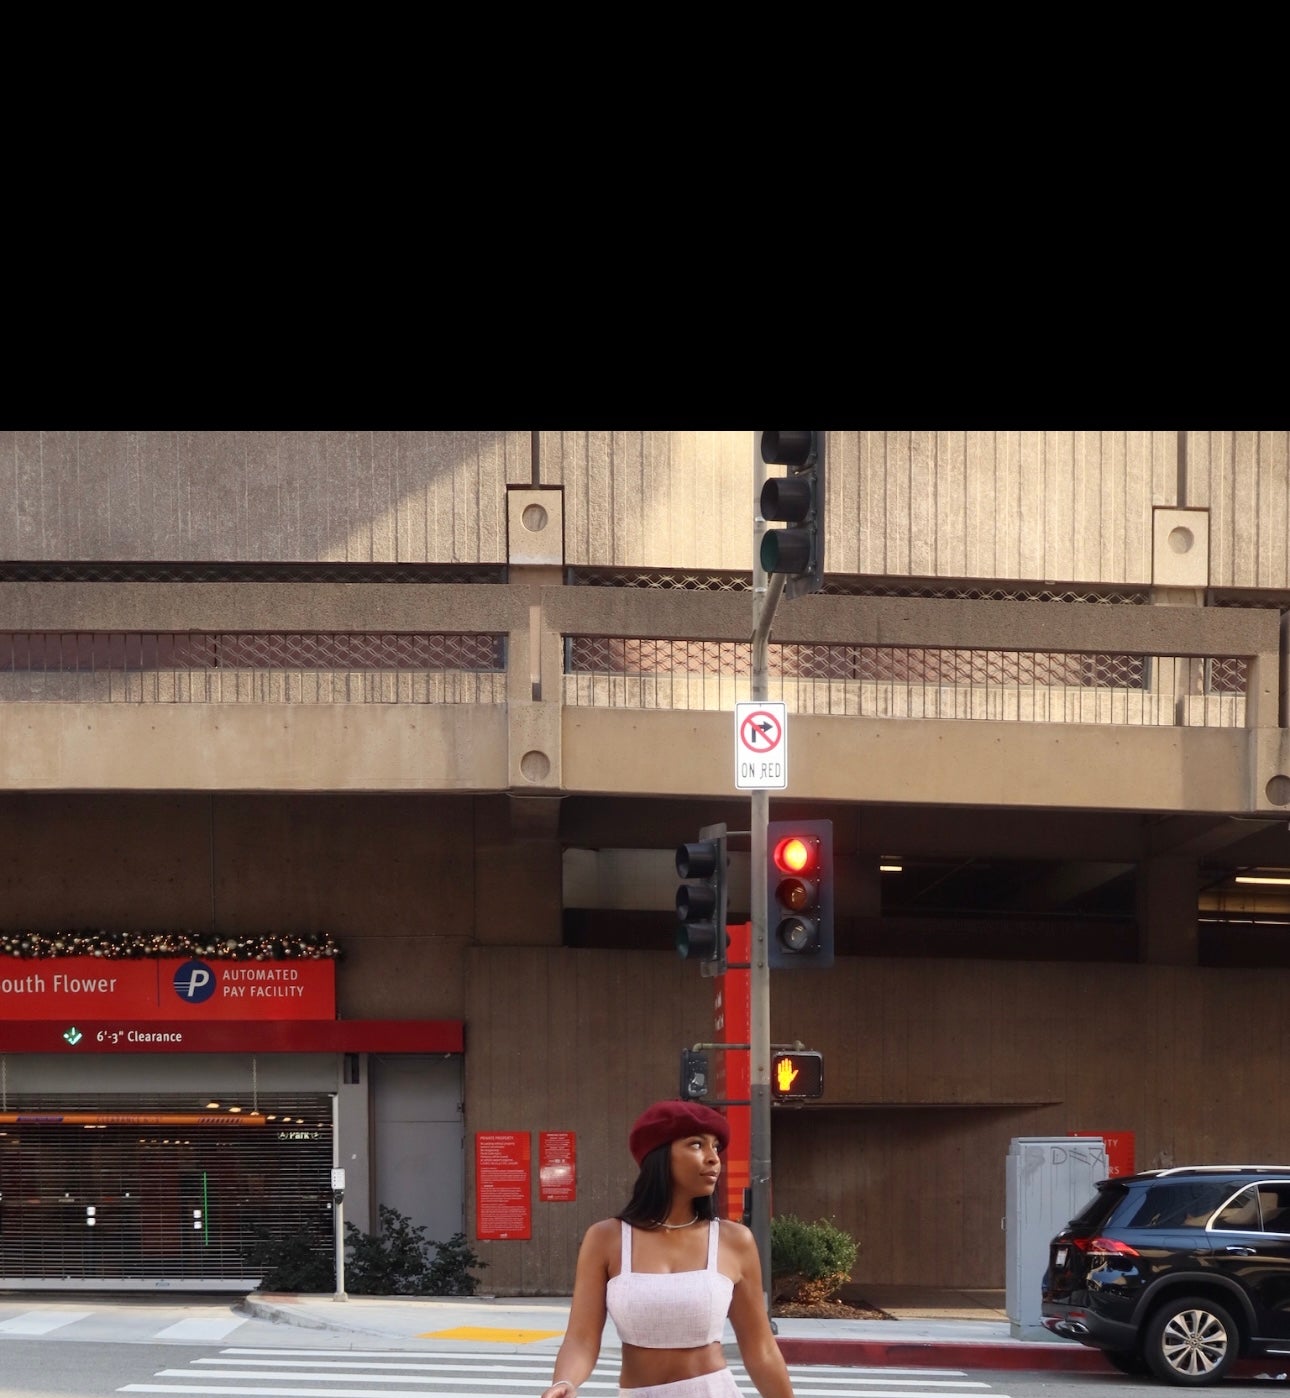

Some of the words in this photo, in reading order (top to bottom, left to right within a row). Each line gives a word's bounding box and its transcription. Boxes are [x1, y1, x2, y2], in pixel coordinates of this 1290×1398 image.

[742, 763, 755, 778] ON
[760, 763, 781, 779] RED
[222, 969, 298, 980] AUTOMATED
[0, 974, 45, 993] outh
[53, 974, 117, 993] Flower
[223, 986, 245, 997] PAY
[250, 986, 304, 997] FACILITY
[127, 1030, 182, 1042] Clearance
